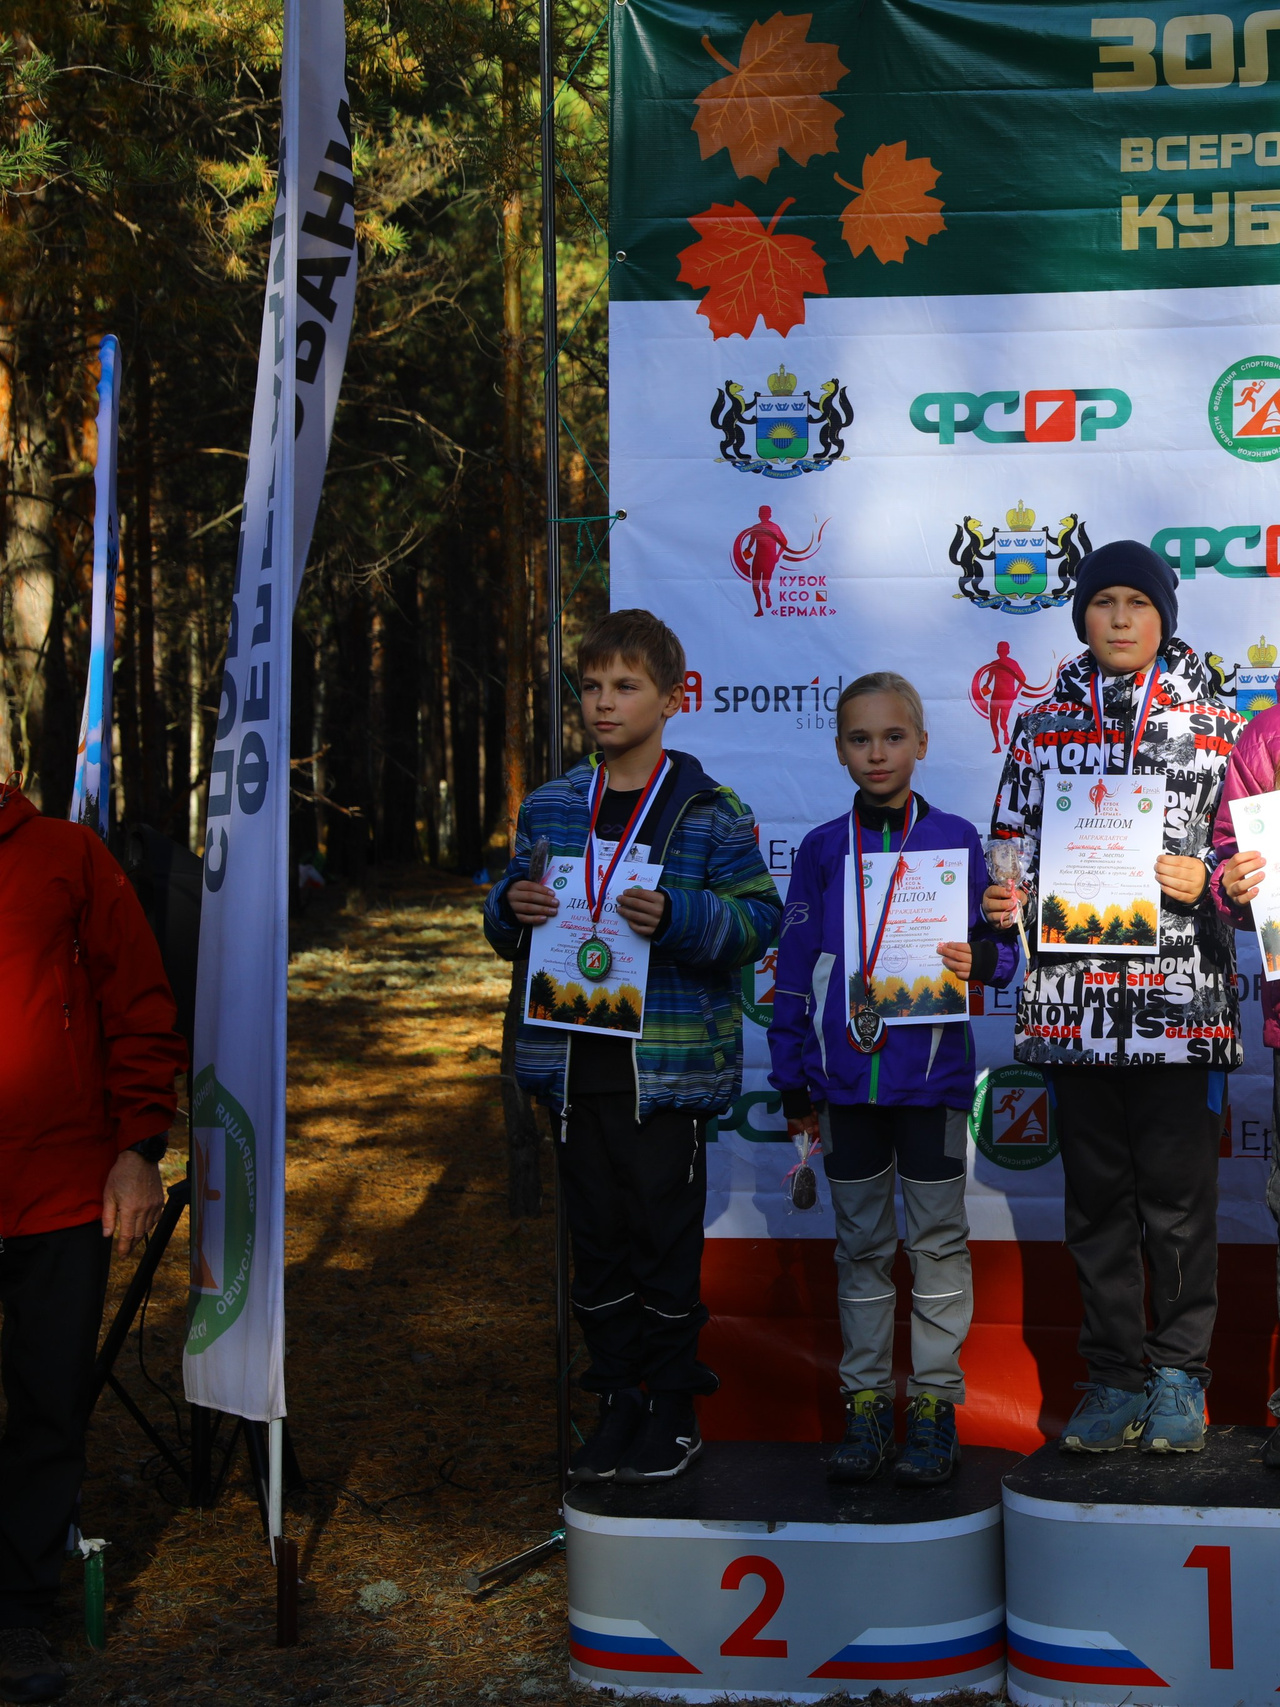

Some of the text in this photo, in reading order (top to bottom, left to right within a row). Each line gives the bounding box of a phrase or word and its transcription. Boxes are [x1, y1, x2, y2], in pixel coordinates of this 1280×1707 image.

[1213, 370, 1238, 412] ФЕДЕРАЦИЯ
[1213, 416, 1234, 447] ОБЛАСТИ
[779, 576, 826, 587] КУБОК
[779, 591, 809, 602] КСО
[771, 606, 837, 617] «ЕРМАК»
[714, 675, 843, 713] SPORTid
[796, 713, 837, 729] sibe
[1074, 818, 1133, 829] ДИПЛОМ
[877, 891, 937, 905] ИПЛОМ
[888, 907, 933, 915] АГРАЖДАЕТСЯ
[720, 1555, 788, 1658] 2
[1183, 1545, 1234, 1670] 1
